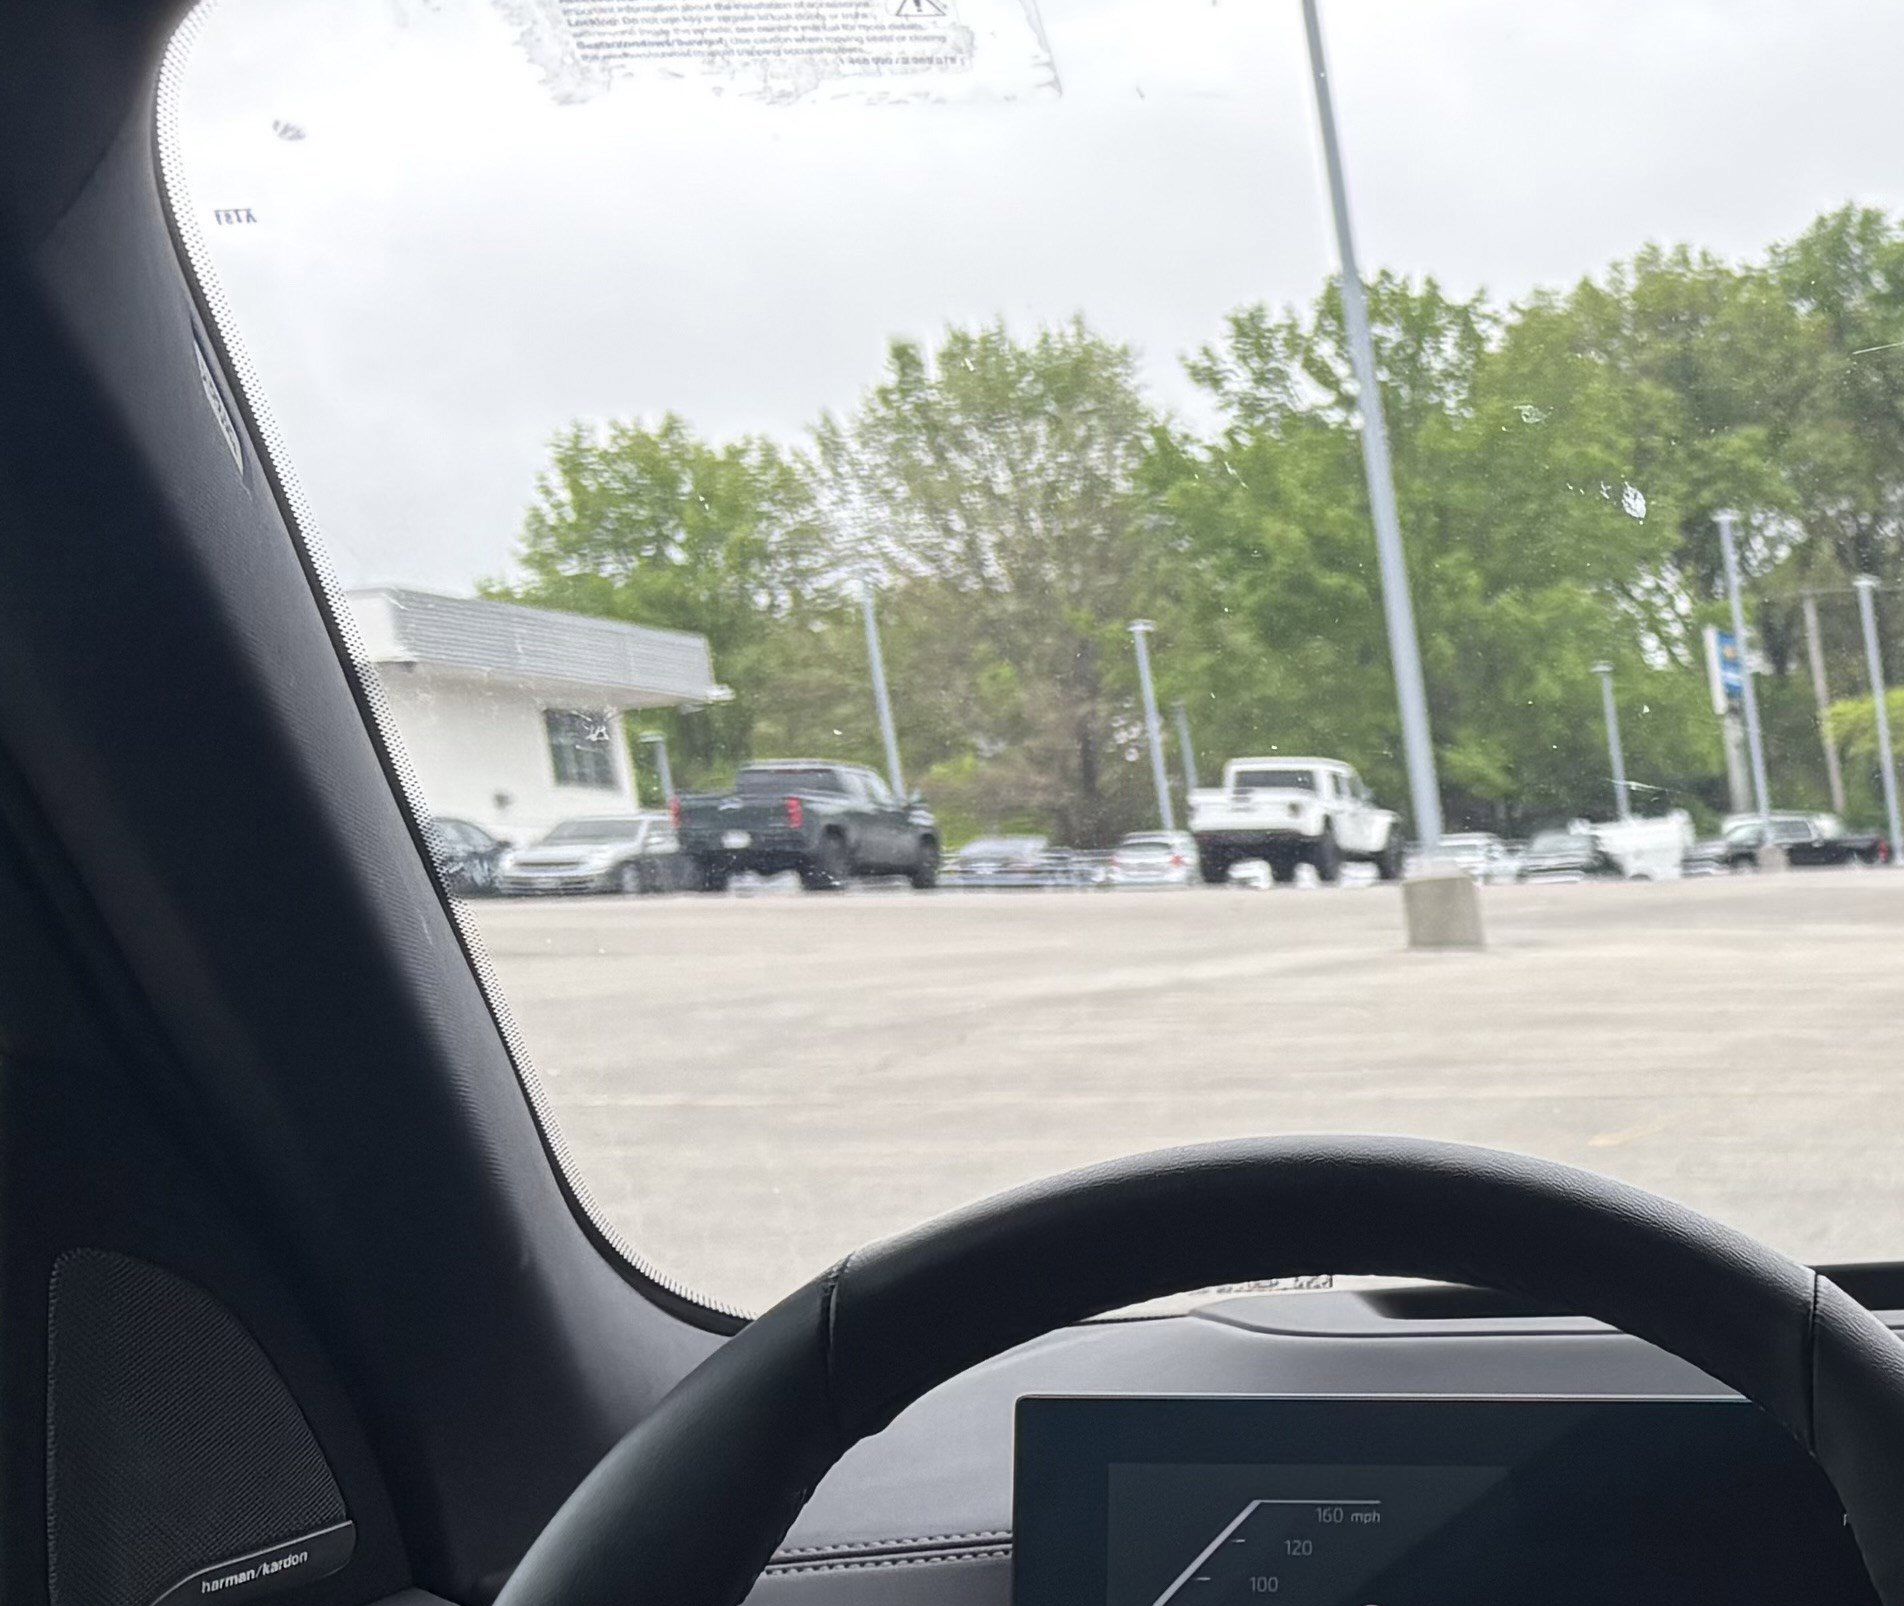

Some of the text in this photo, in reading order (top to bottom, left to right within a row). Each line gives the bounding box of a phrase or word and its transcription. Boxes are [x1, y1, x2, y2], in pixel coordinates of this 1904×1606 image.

[1315, 1506, 1381, 1524] 160 mph
[1284, 1539, 1313, 1556] 120
[201, 1551, 309, 1594] harman/kardon
[1250, 1575, 1279, 1593] 100
